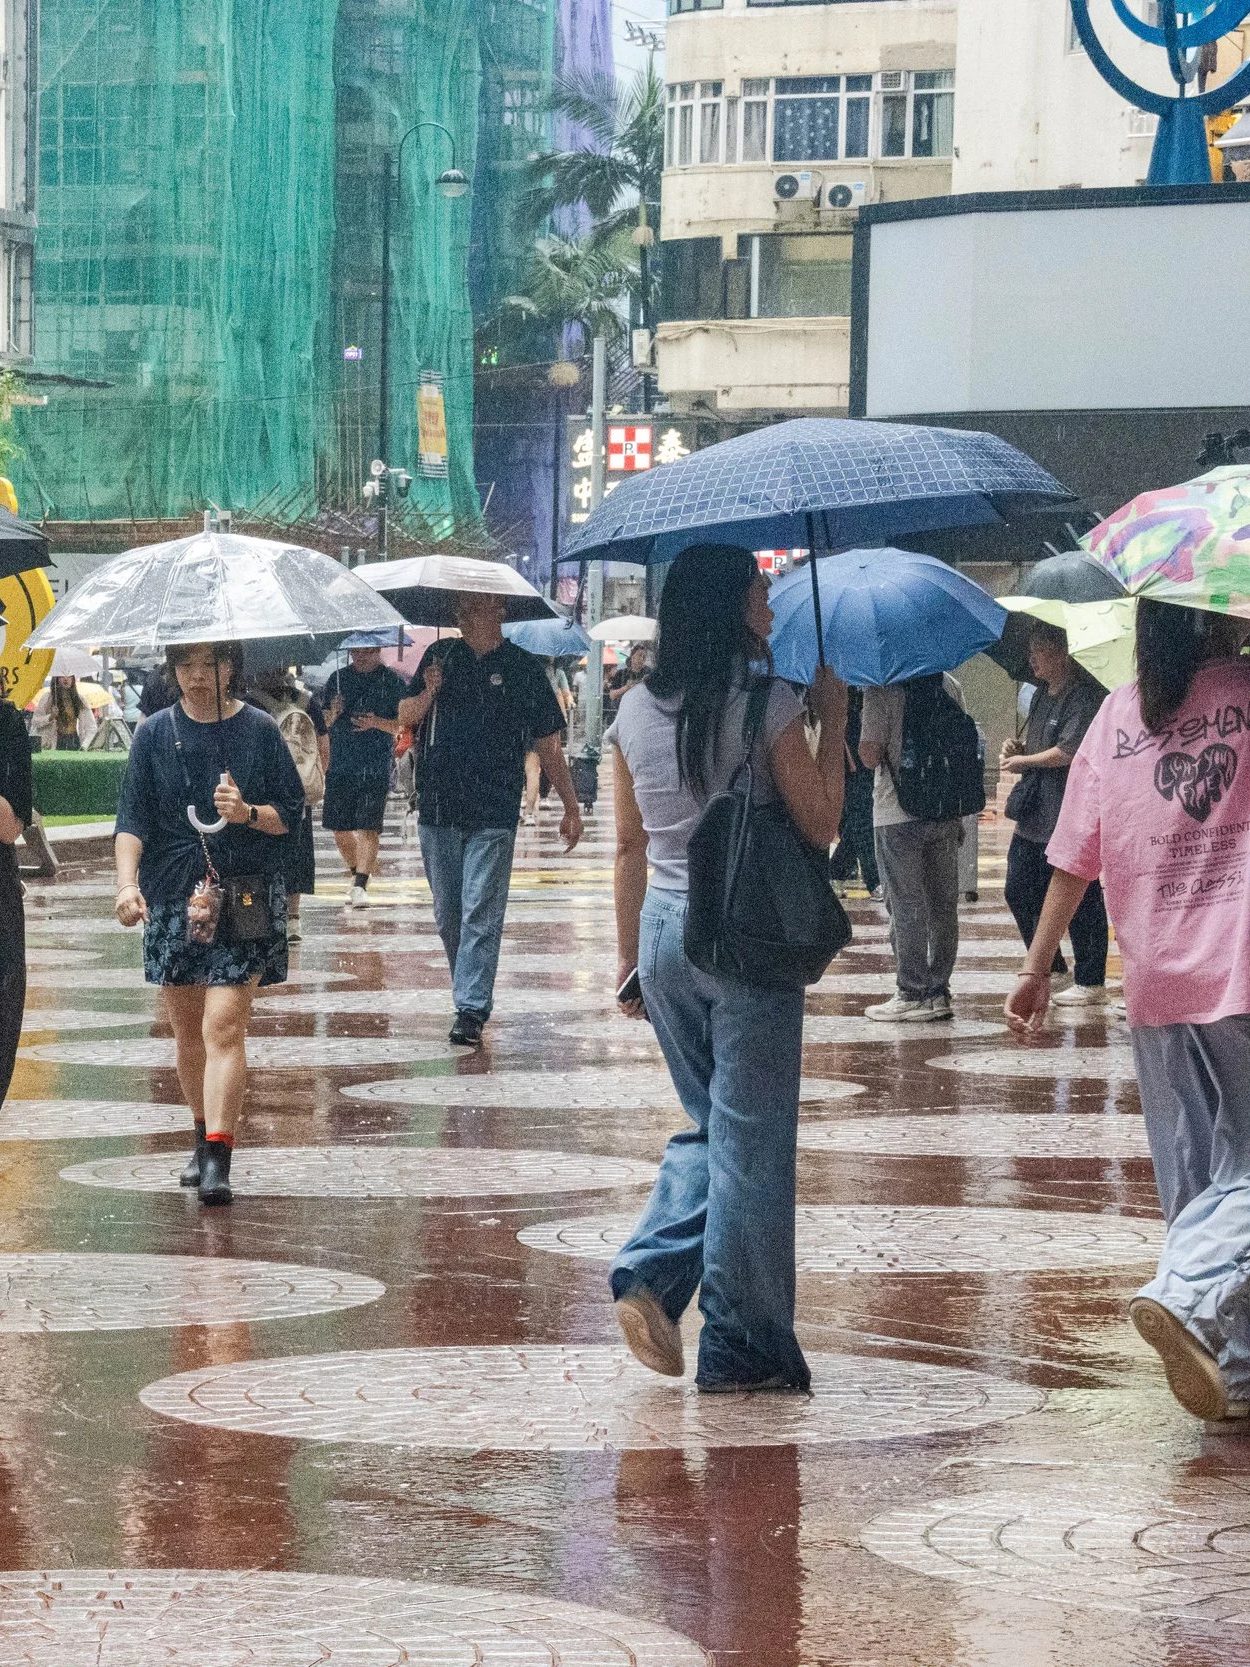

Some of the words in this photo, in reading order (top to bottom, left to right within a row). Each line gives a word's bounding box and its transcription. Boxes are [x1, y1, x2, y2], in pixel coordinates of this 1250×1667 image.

[1150, 833, 1182, 846] BOLD
[1184, 821, 1250, 841] CONFIDENT
[1170, 838, 1237, 858] TIMELESS
